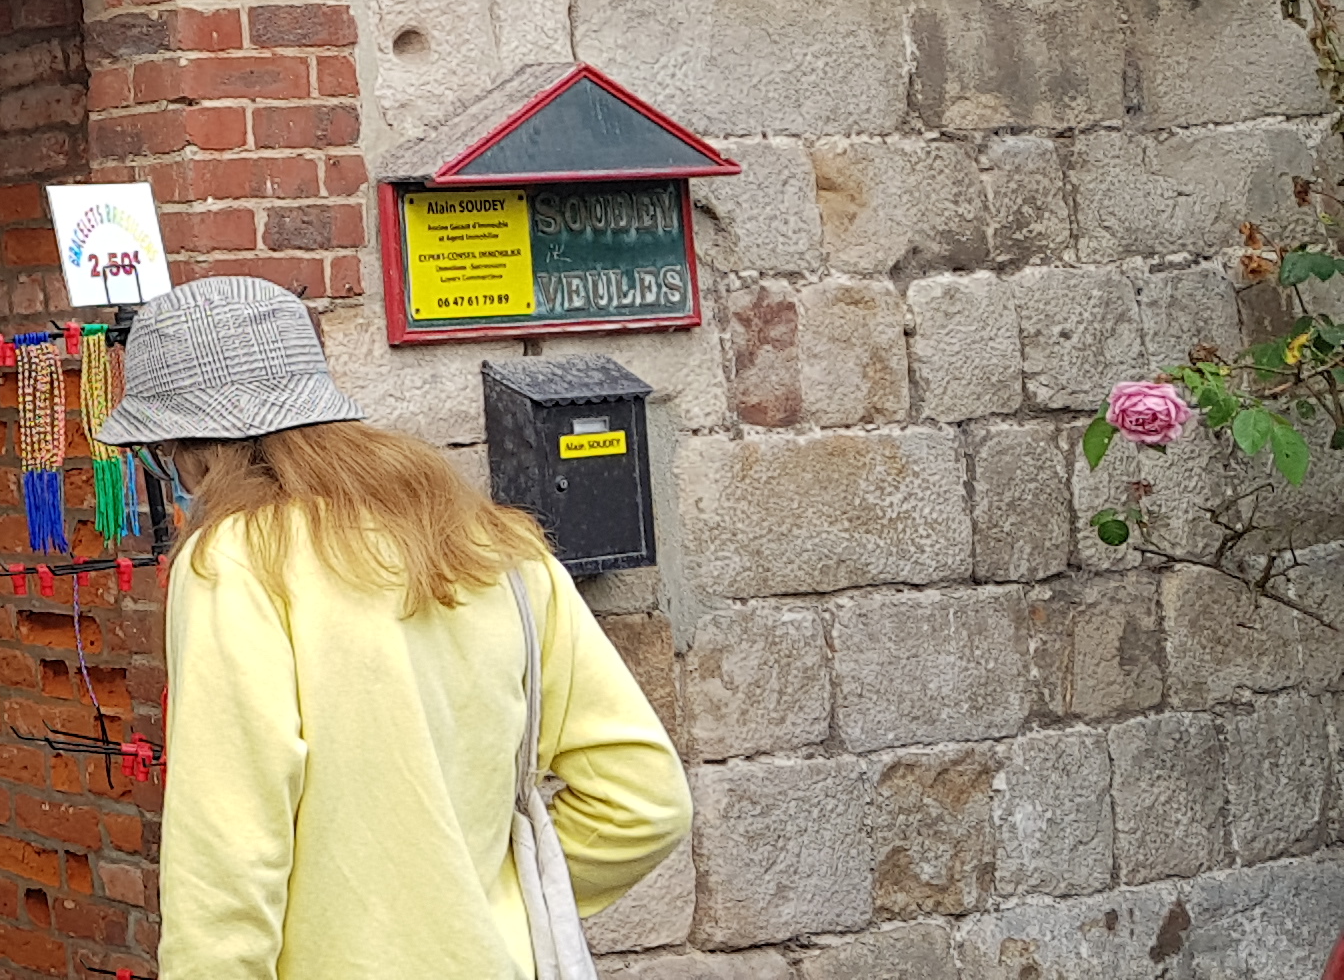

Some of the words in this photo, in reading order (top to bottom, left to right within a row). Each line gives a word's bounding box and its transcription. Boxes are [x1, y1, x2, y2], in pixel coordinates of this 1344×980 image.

[427, 201, 457, 215] Alain
[458, 199, 506, 213] SOUDEY
[535, 188, 676, 235] SOUDEY
[437, 298, 450, 308] 06
[452, 296, 465, 307] 47
[467, 295, 479, 306] 61
[482, 294, 495, 305] 79
[497, 293, 509, 304] 89
[536, 265, 685, 314] VEULES
